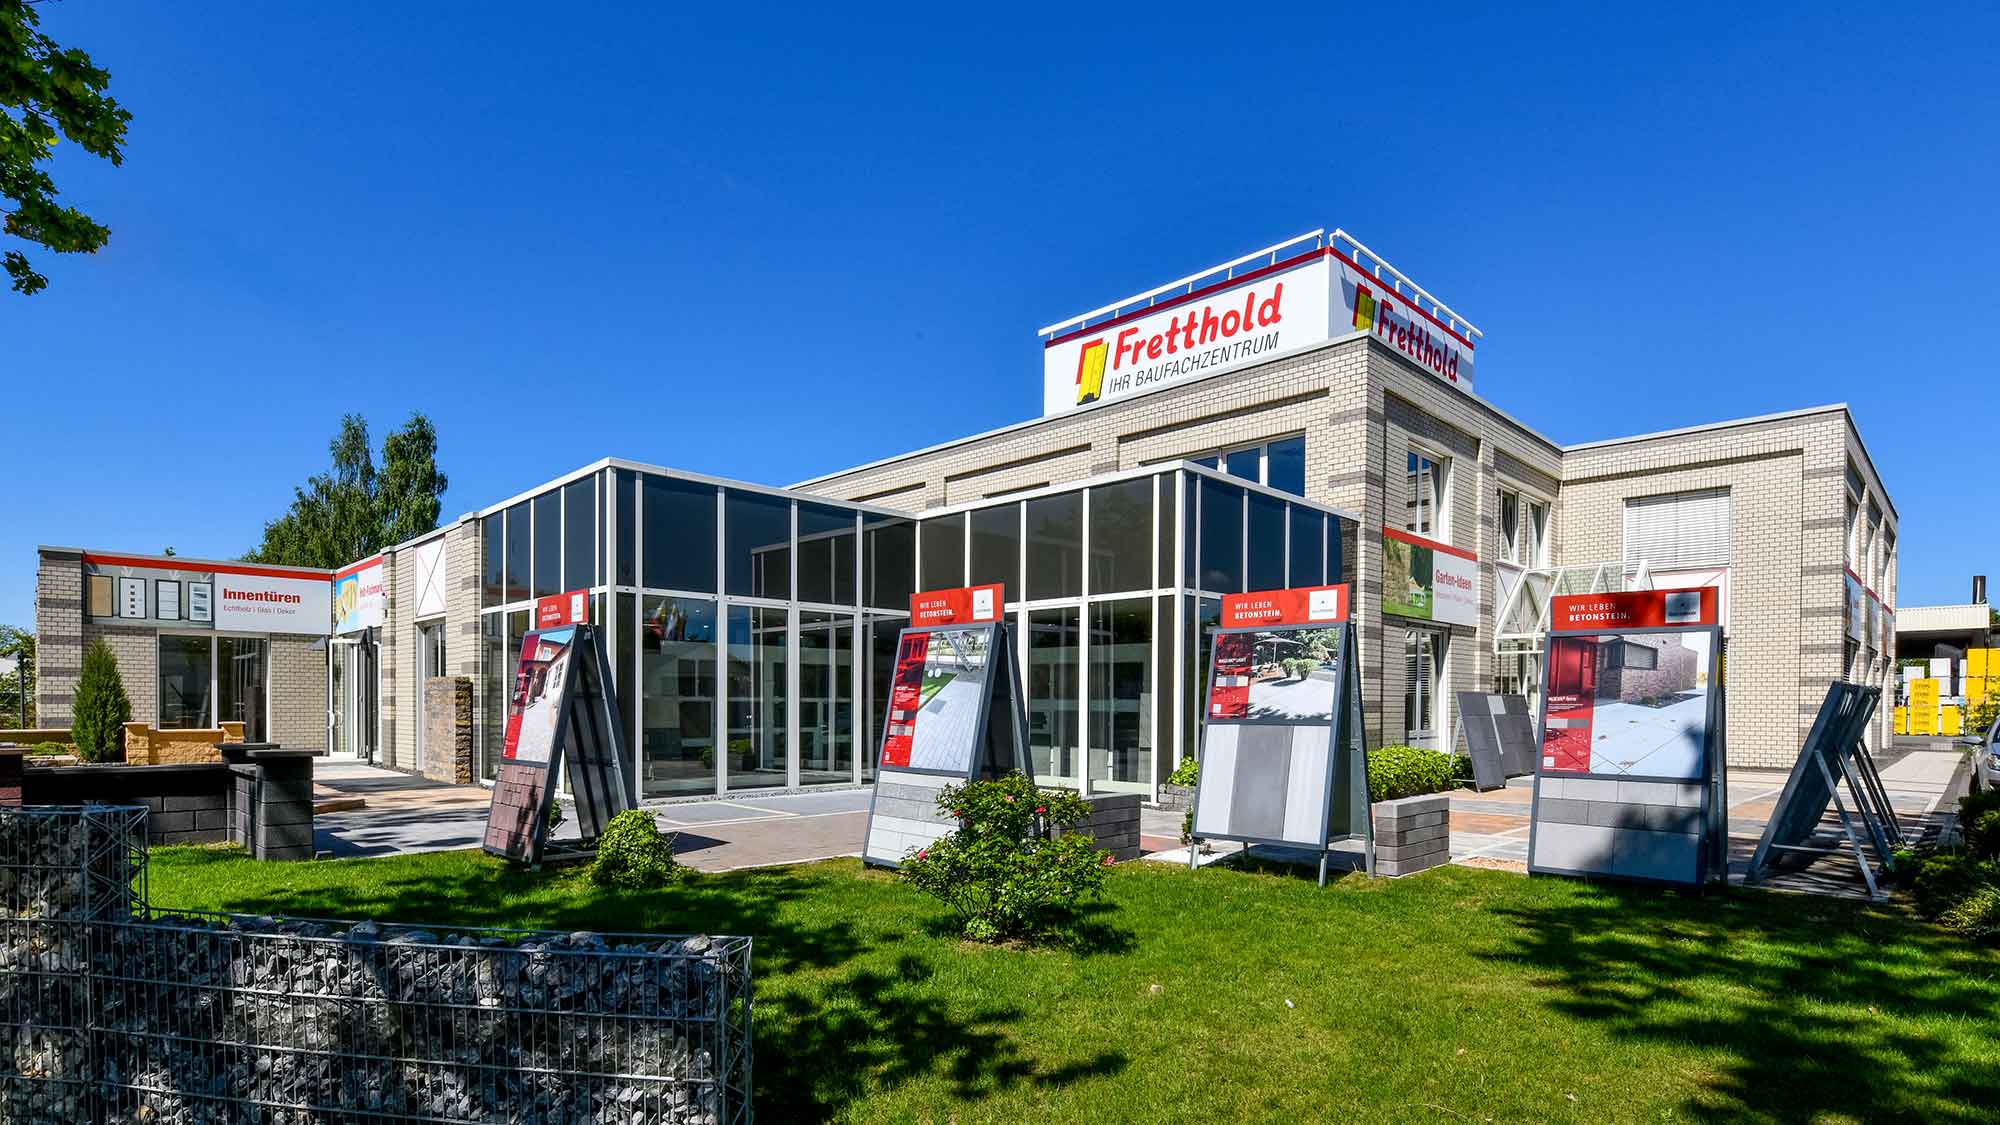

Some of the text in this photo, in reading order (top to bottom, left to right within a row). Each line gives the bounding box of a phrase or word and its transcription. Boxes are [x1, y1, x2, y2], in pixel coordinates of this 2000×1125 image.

[1113, 282, 1283, 370] Fretthold
[1378, 299, 1458, 383] Fretthold
[1109, 331, 1280, 393] IHR BAUFACHZENTRUM
[223, 588, 301, 603] Innentüren
[1251, 600, 1272, 609] LEBEN
[1569, 602, 1616, 612] WIR LEBEN
[1569, 611, 1631, 621] BETONSTEIN.
